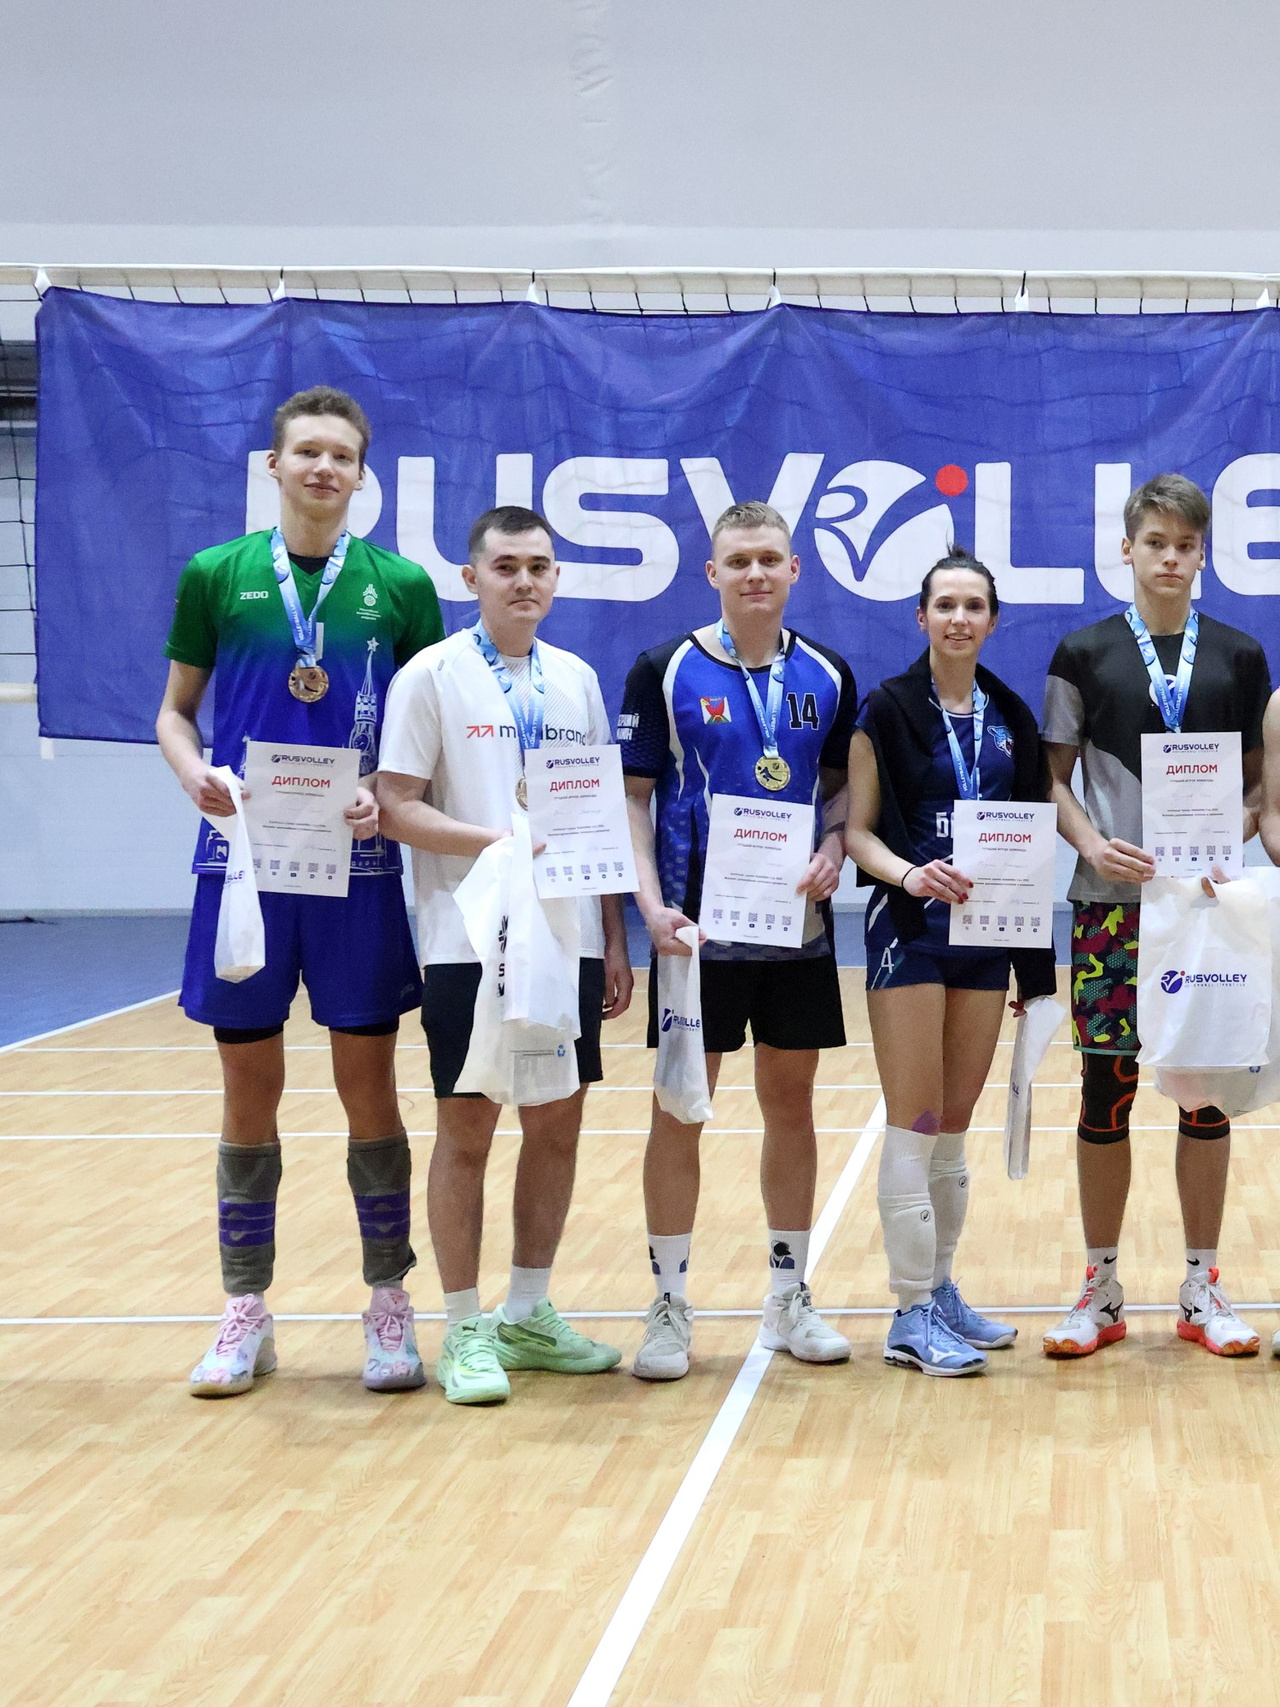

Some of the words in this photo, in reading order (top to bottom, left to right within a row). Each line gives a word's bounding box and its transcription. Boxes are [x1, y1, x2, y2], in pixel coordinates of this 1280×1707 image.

[240, 590, 269, 600] ZEDO
[786, 692, 820, 730] 14
[1172, 743, 1220, 751] RUSVOLLEY
[282, 754, 335, 765] RUSVOLLEY
[555, 757, 601, 766] RUSVOLLEY
[1166, 764, 1218, 775] ДИПЛОМ
[271, 776, 331, 789] ДИПЛОМ
[550, 779, 600, 792] ДИПЛОМ
[743, 808, 792, 819] RUSVOLLEY
[986, 811, 1035, 820] RUSVOLLEY
[734, 828, 787, 843] ДИПЛОМ
[978, 832, 1032, 844] ДИПЛОМ
[1185, 973, 1248, 984] RUSVOLLEY
